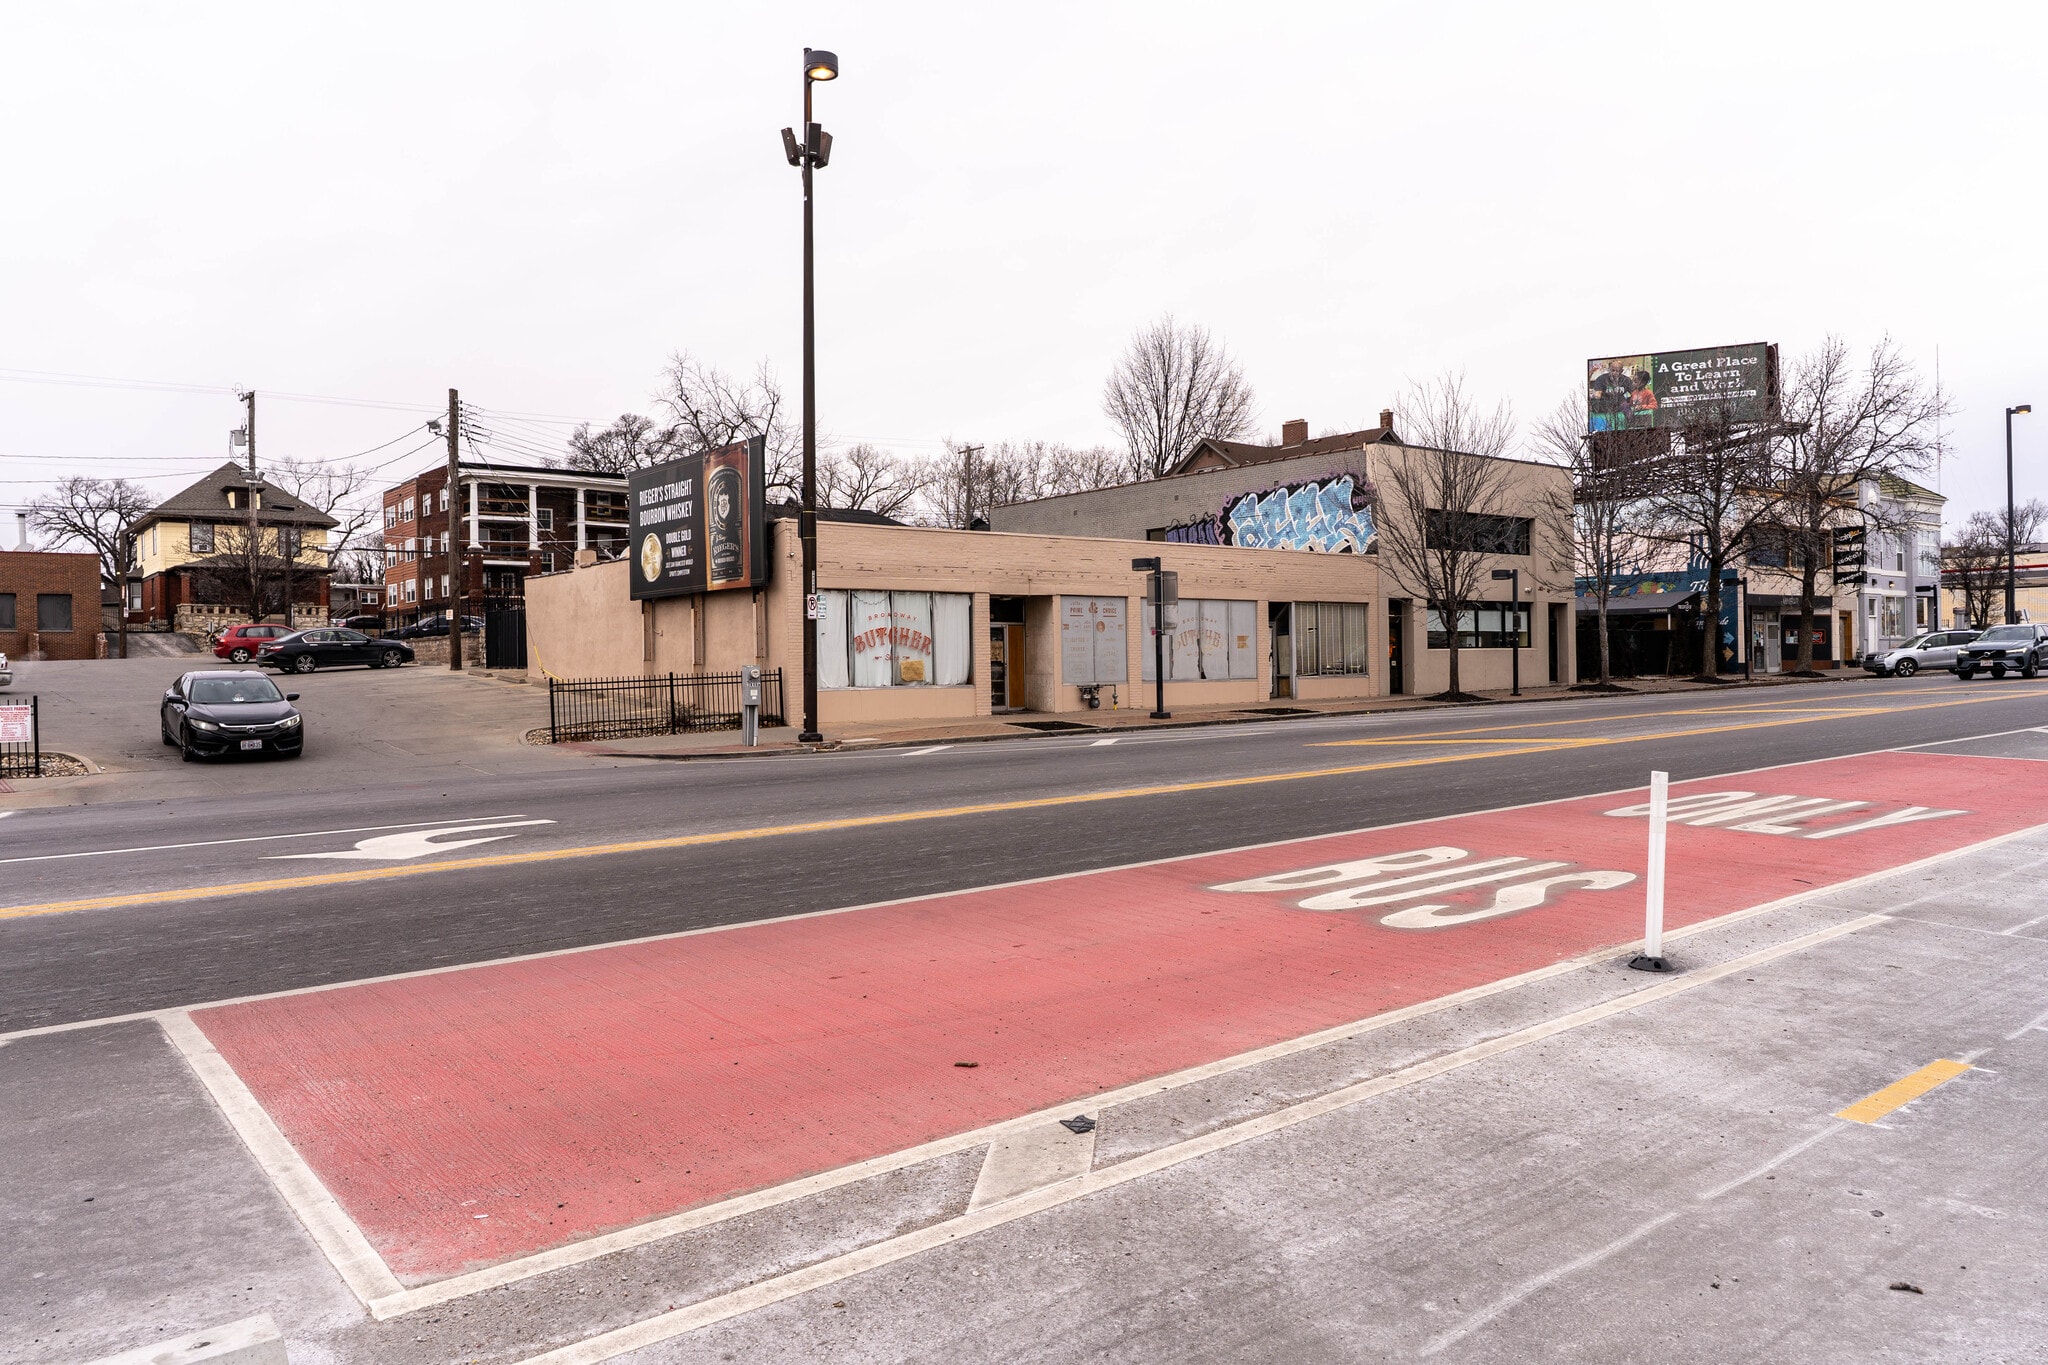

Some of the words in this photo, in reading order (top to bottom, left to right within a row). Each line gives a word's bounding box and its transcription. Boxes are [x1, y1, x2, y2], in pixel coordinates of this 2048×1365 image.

[1658, 363, 1669, 373] A
[1671, 360, 1712, 372] Great
[1717, 357, 1758, 368] Place
[1675, 372, 1692, 382] To
[1696, 370, 1741, 381] Learn
[1670, 382, 1699, 393] and
[1702, 378, 1746, 390] Work
[640, 486, 664, 506] RIEGER'S
[664, 479, 692, 501] STRAIGHT
[640, 506, 666, 527] BOURBON
[666, 500, 692, 521] WHISKEY
[1690, 579, 1724, 592] Tit's
[1088, 601, 1099, 614] &
[868, 612, 917, 621] BROADWAY
[853, 626, 932, 656] BUTCHER
[1603, 791, 1968, 839] ONLY
[1206, 846, 1637, 930] BUS
